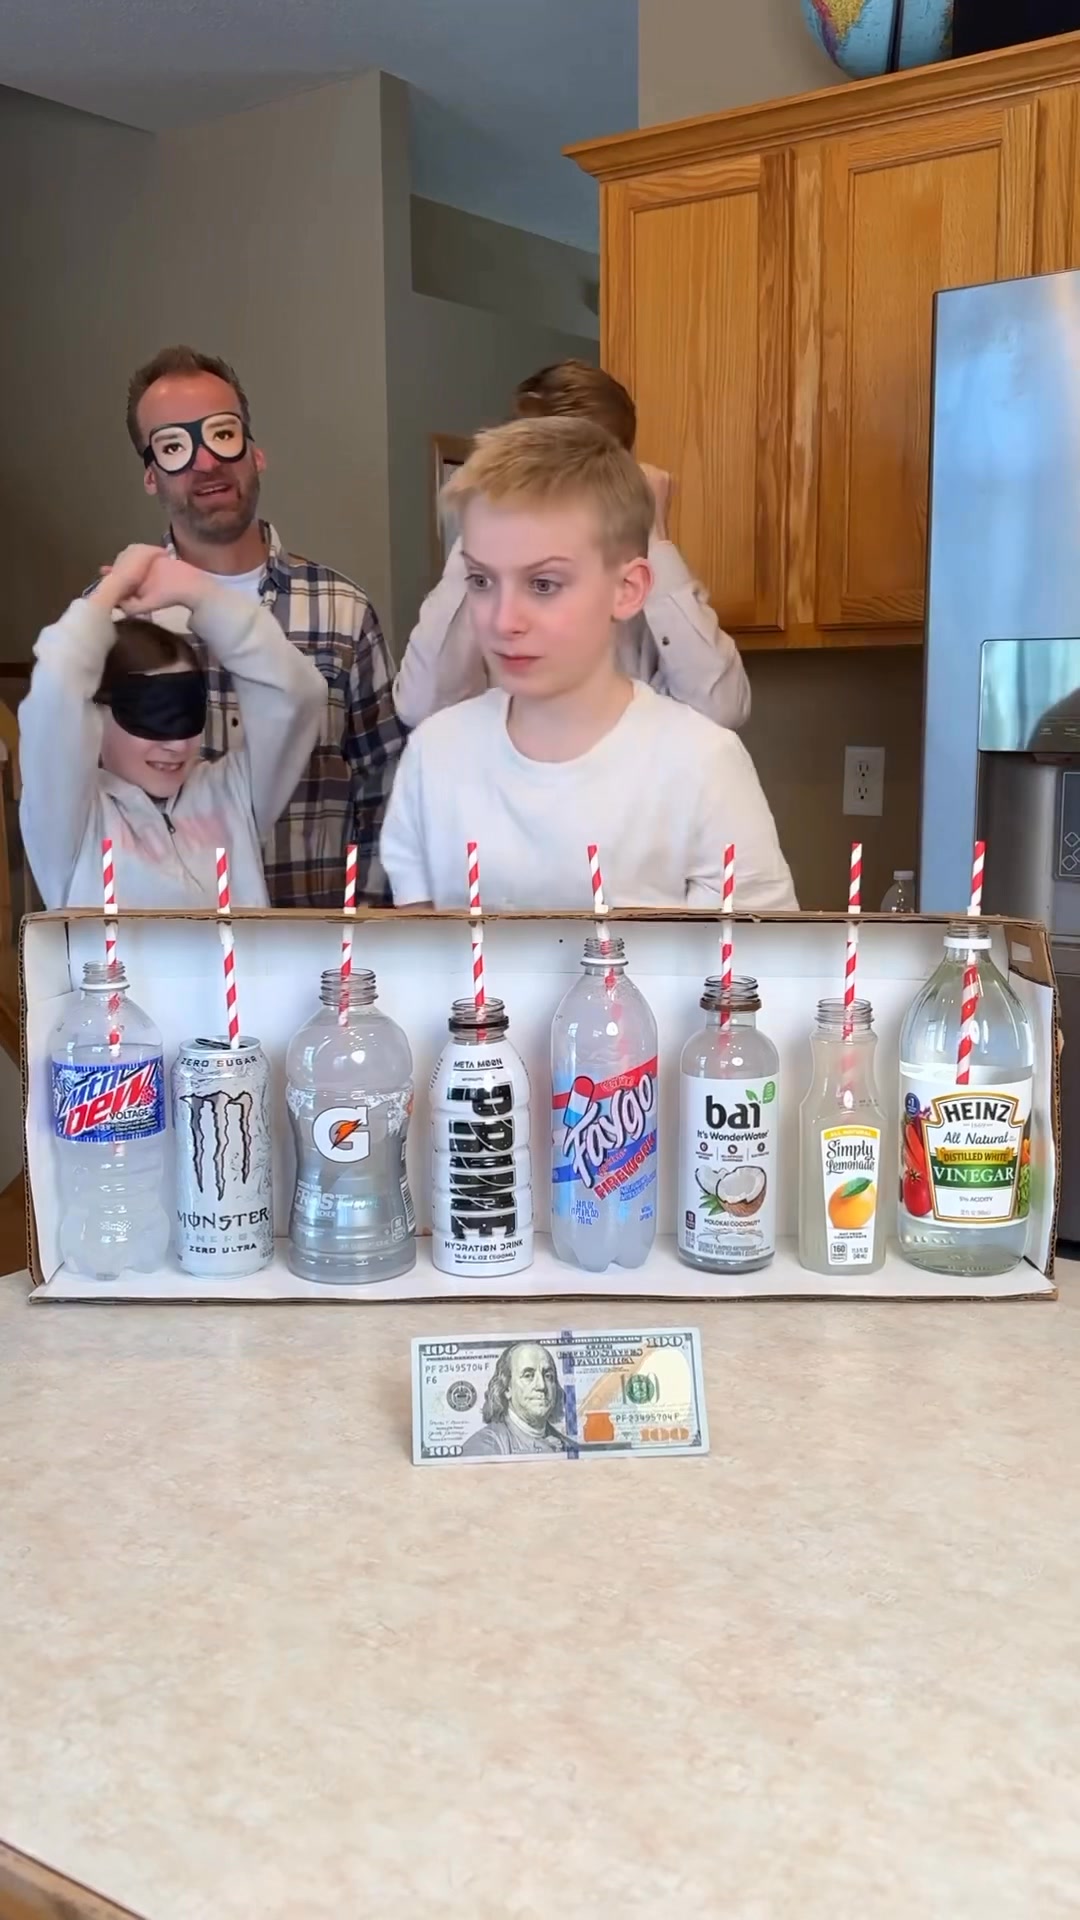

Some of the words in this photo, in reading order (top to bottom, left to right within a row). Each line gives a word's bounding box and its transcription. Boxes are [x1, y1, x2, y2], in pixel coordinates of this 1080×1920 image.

[180, 1057, 210, 1068] ZERO
[216, 1055, 258, 1068] SUGAR
[453, 1060, 475, 1069] META
[477, 1057, 503, 1068] MOON
[109, 1108, 149, 1121] VOLTAGE
[705, 1089, 761, 1130] bai
[943, 1101, 1011, 1123] HEINZ
[312, 1105, 371, 1164] G
[563, 1072, 654, 1189] Faygo
[696, 1129, 708, 1139] It's
[709, 1131, 768, 1141] WonderWater
[943, 1131, 961, 1144] All
[964, 1131, 1009, 1145] Natural
[826, 1139, 876, 1161] Simply
[943, 1151, 983, 1162] DISTILLED
[984, 1151, 1008, 1162] WHITE
[447, 1081, 518, 1240] PRIME
[593, 1131, 657, 1201] FIREWORK
[826, 1159, 875, 1175] Lemonade
[933, 1166, 1015, 1183] VINEGAR
[177, 1207, 269, 1231] MONSTER
[189, 1245, 217, 1254] ZERO
[222, 1243, 257, 1254] ULTRA
[444, 1240, 497, 1253] HYDRATION
[499, 1239, 524, 1251] DRINK
[645, 1335, 683, 1349] 100
[423, 1343, 459, 1356] 100
[425, 1364, 437, 1373] PF
[438, 1362, 483, 1374] 23495704
[484, 1362, 490, 1371] F
[426, 1375, 437, 1385] F6
[640, 1427, 690, 1441] 100
[427, 1444, 463, 1457] 100
